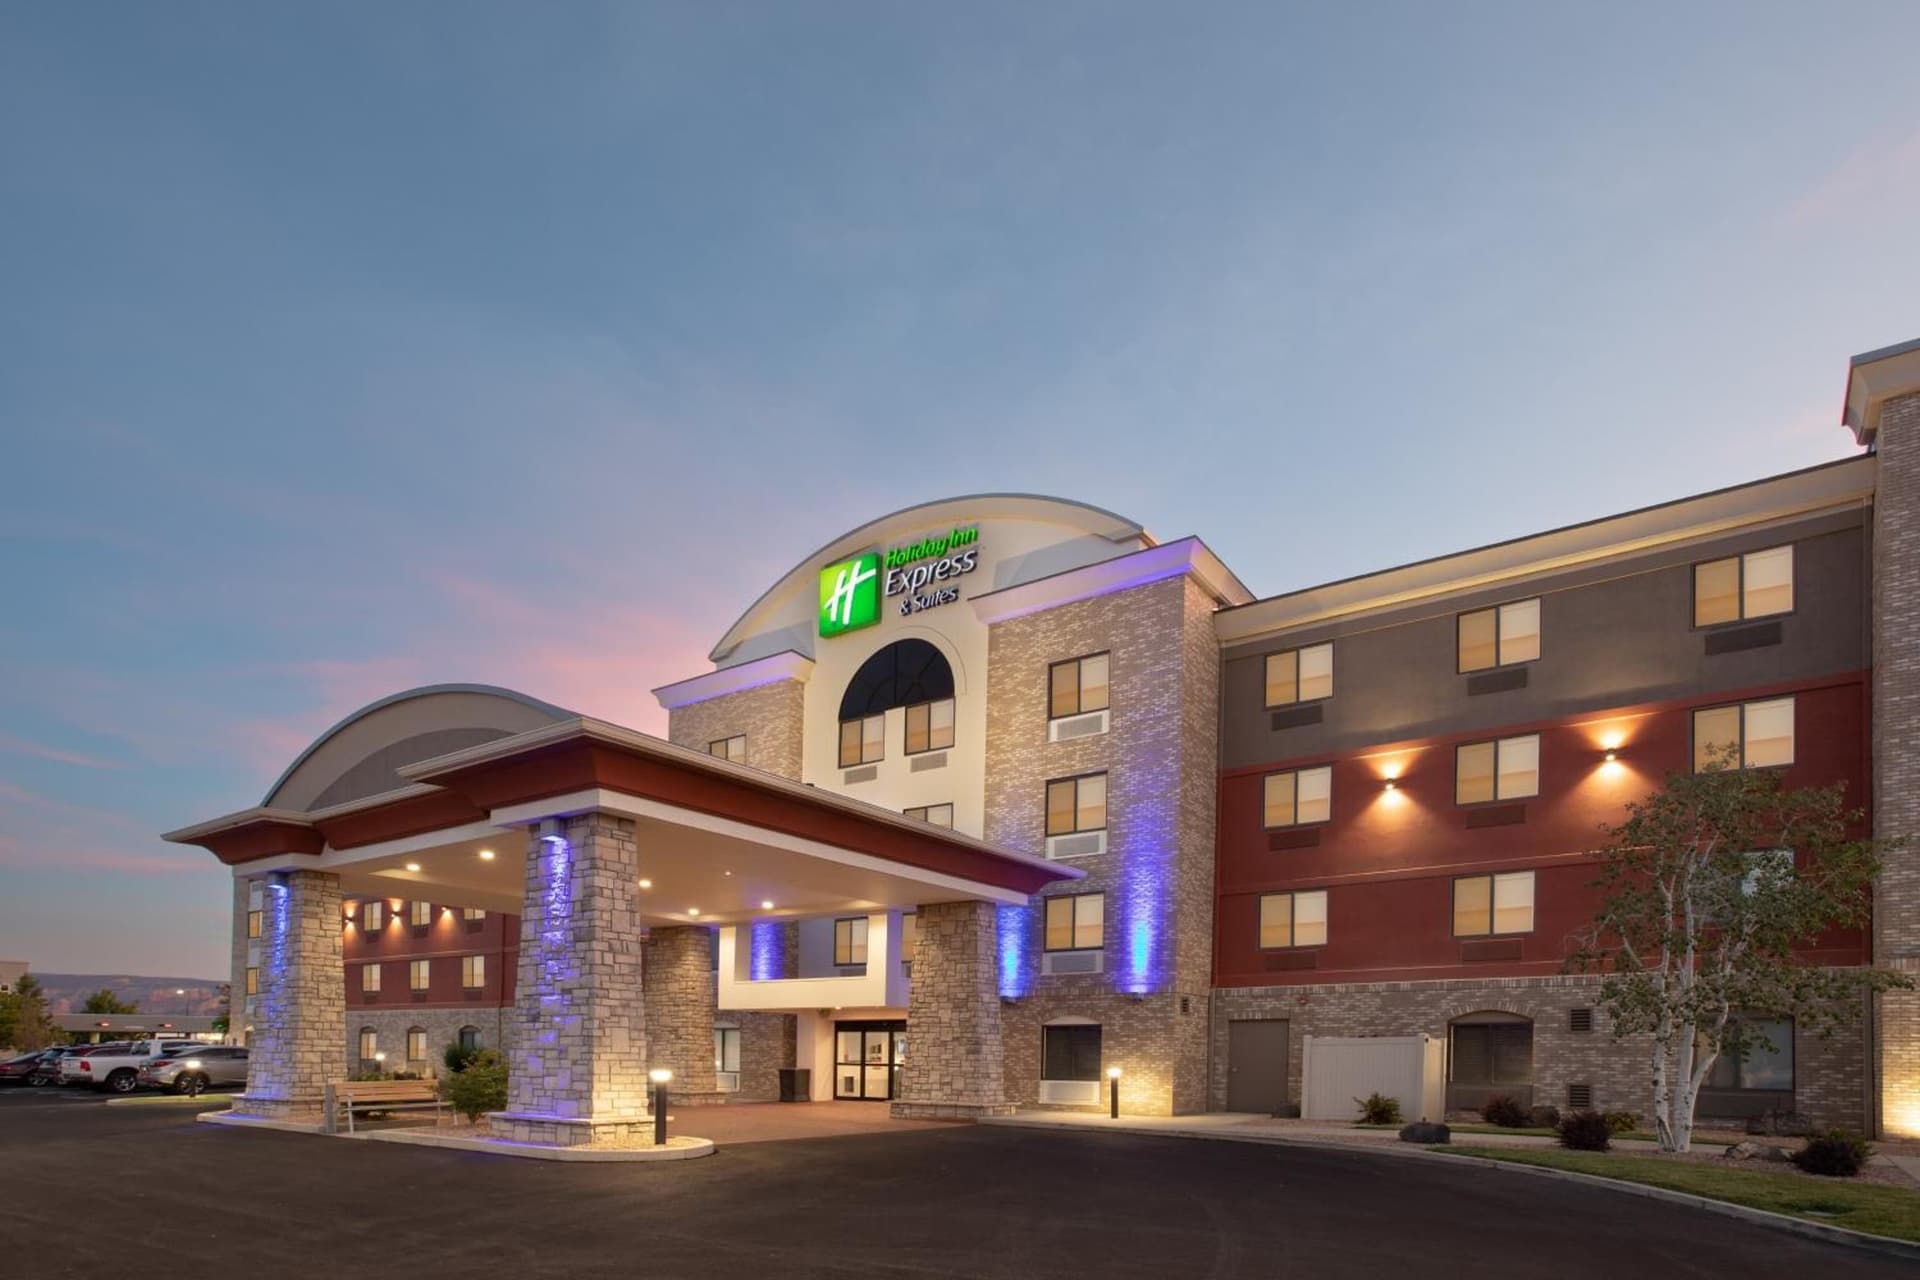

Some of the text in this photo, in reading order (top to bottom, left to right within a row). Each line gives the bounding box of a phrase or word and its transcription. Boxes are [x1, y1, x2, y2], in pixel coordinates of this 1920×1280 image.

[885, 528, 978, 568] Holiday Inn
[886, 550, 978, 596] Express
[900, 587, 959, 616] & Suites
